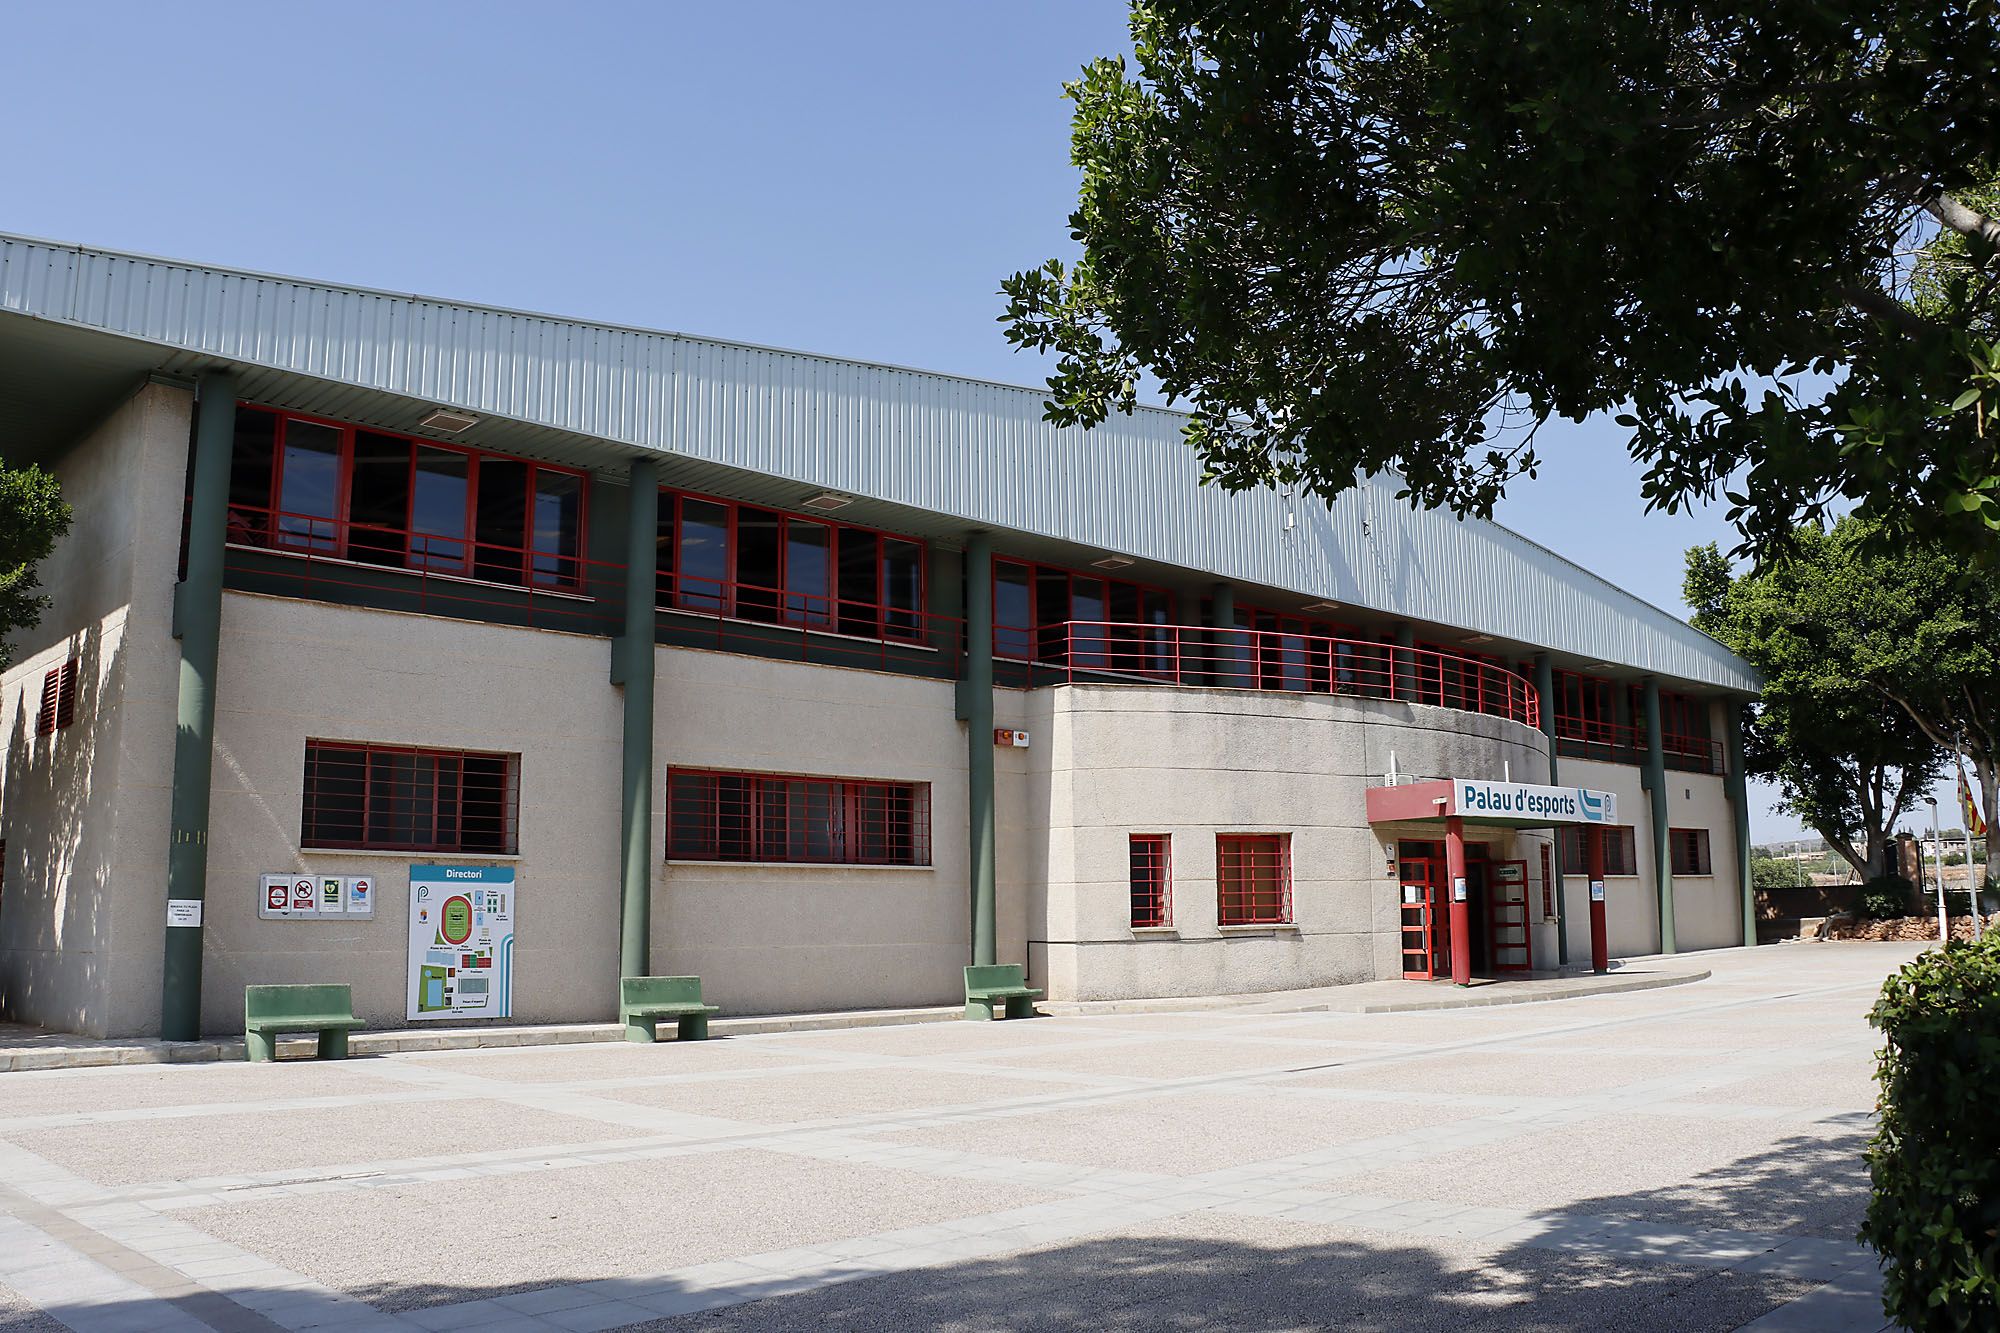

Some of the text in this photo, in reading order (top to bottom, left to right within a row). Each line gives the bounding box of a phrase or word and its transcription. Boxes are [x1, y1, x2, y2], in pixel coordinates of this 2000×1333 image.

[1464, 785, 1575, 818] Palau d'esports
[446, 869, 482, 878] Directori
